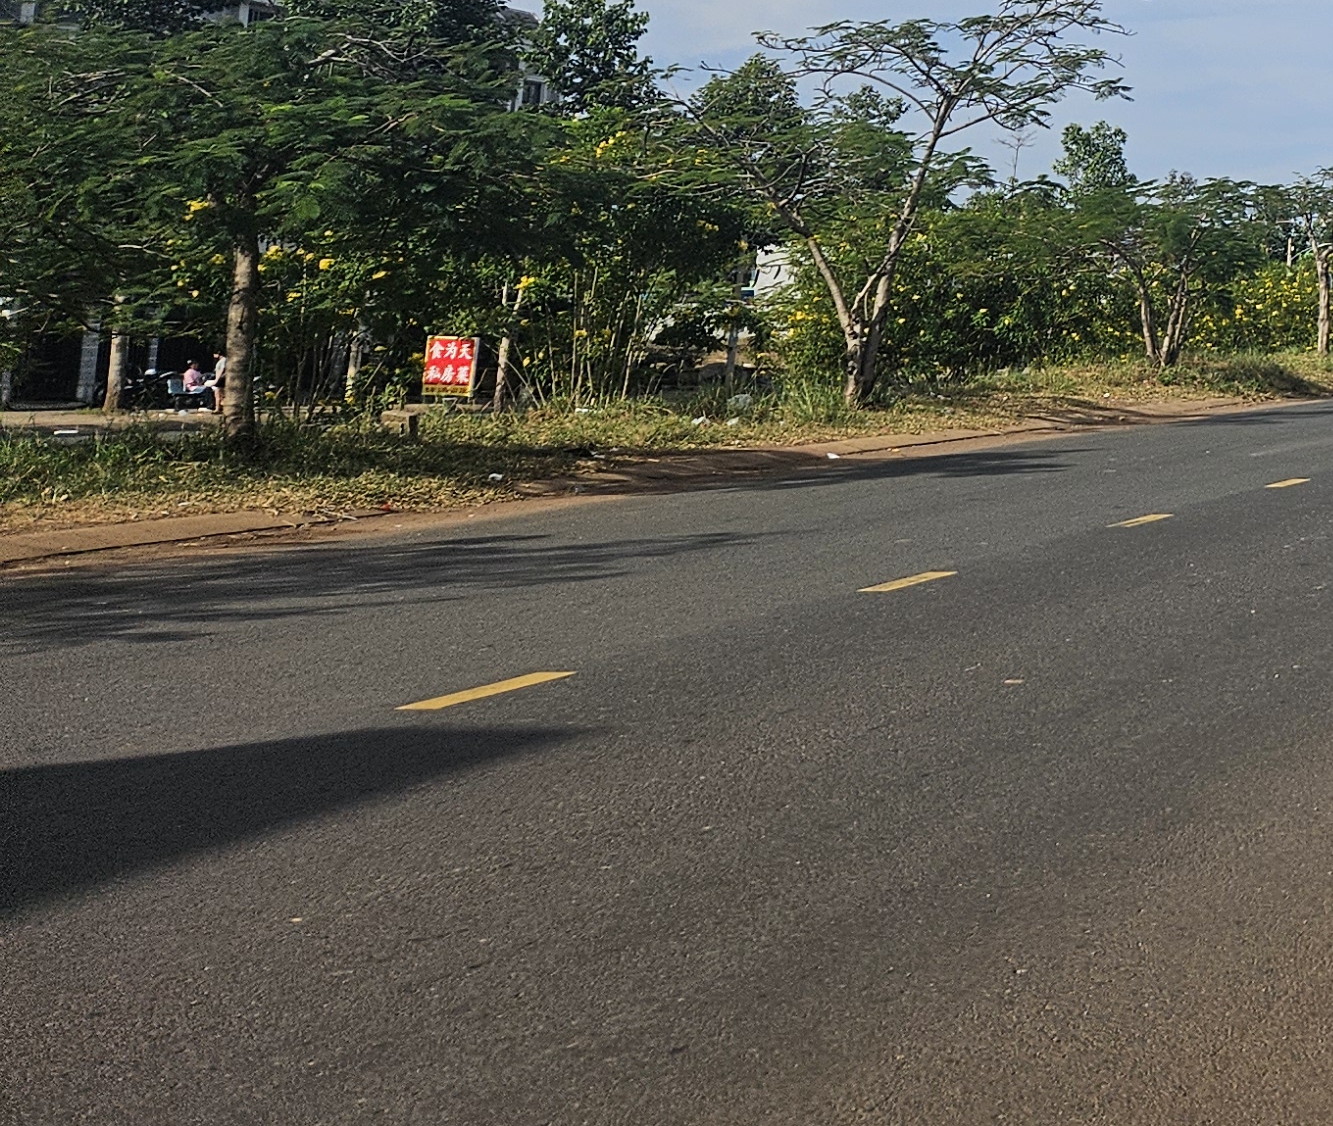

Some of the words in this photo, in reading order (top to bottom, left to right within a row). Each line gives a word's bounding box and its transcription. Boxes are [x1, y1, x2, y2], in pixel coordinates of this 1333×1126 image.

[429, 341, 473, 360] 食为天
[426, 364, 470, 384] 私房菜
